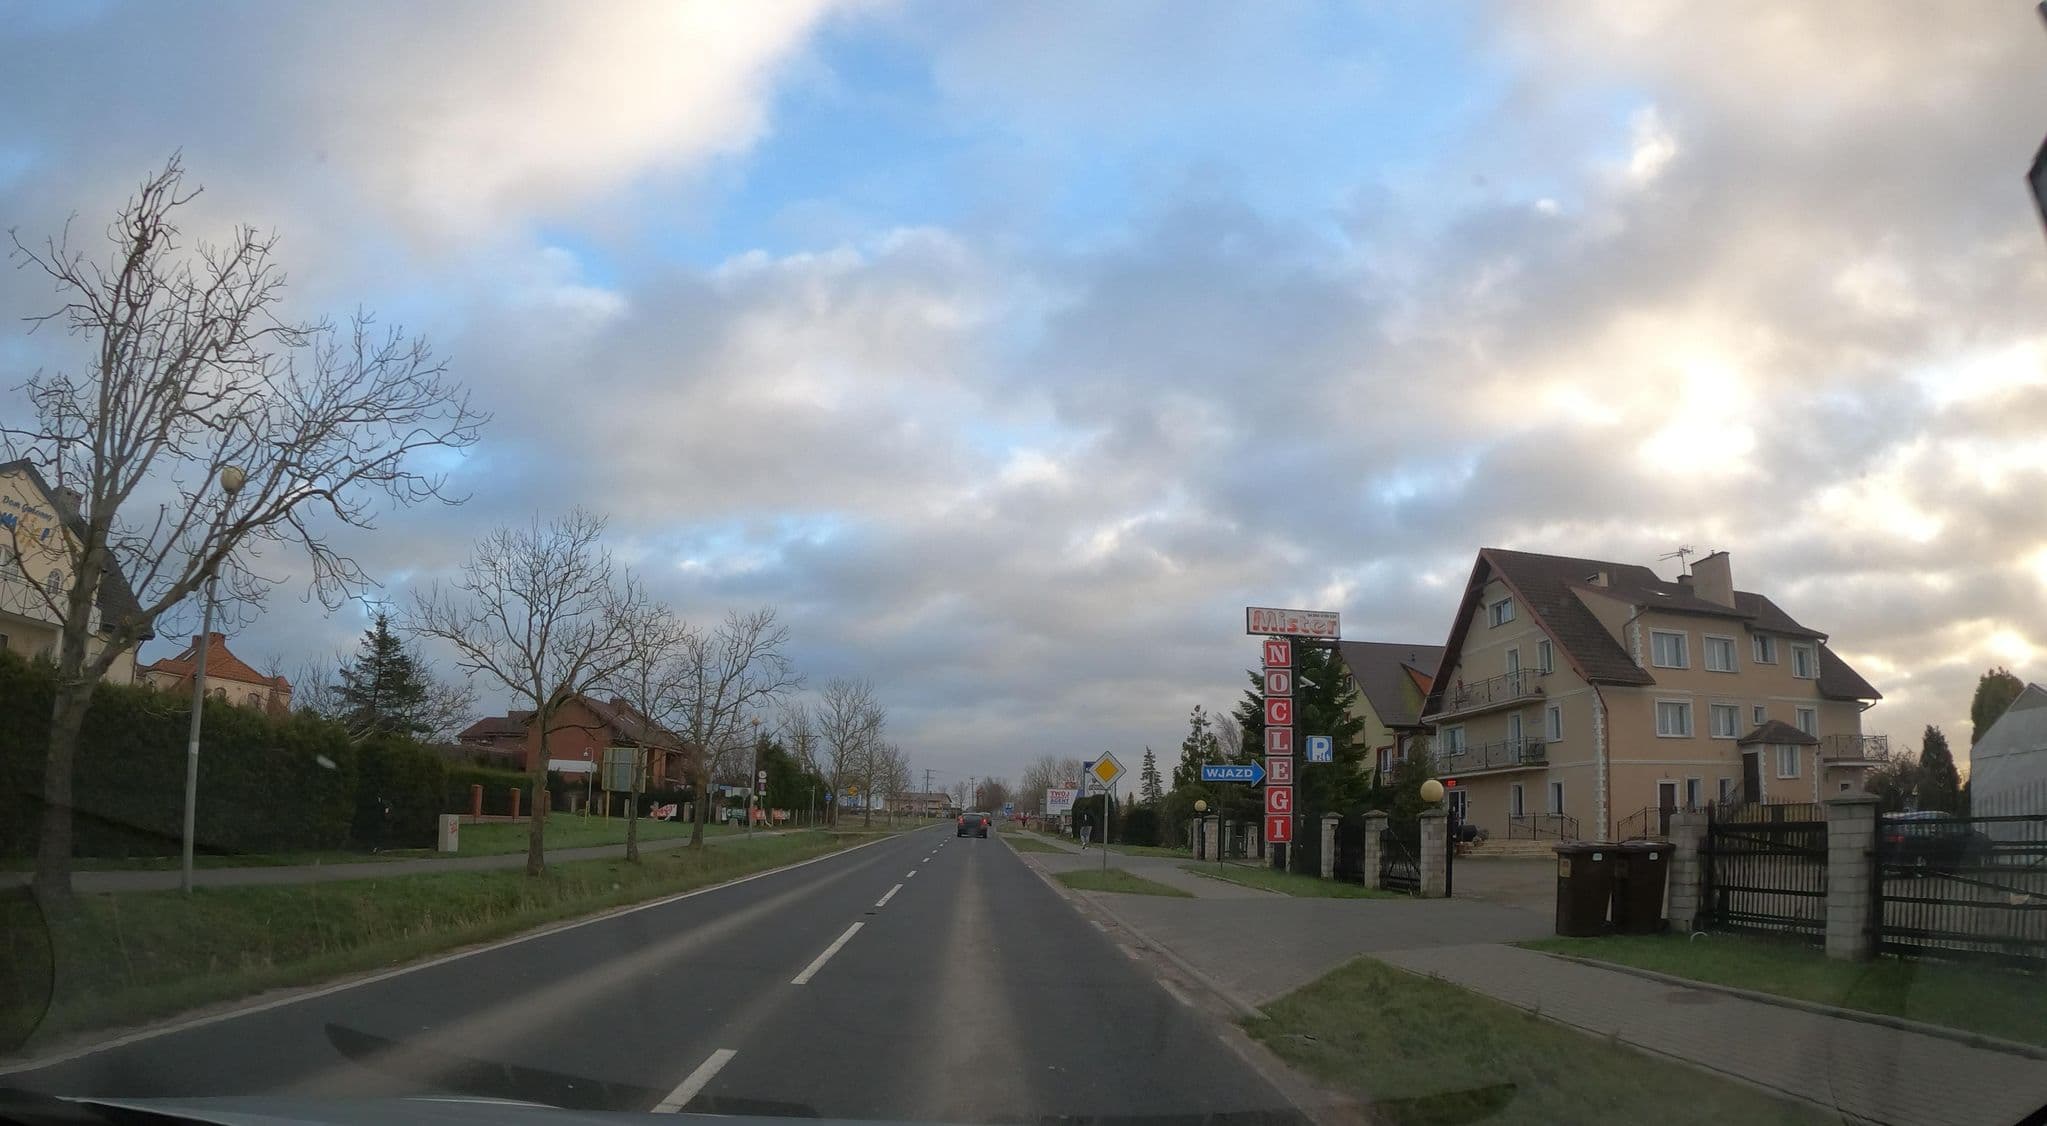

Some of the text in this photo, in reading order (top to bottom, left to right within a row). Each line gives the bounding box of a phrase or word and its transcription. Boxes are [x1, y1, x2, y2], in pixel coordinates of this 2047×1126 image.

[3, 495, 20, 509] Dom
[1252, 609, 1337, 635] Mister
[1268, 645, 1289, 839] NOCLEGI
[1206, 767, 1253, 779] WJAZD
